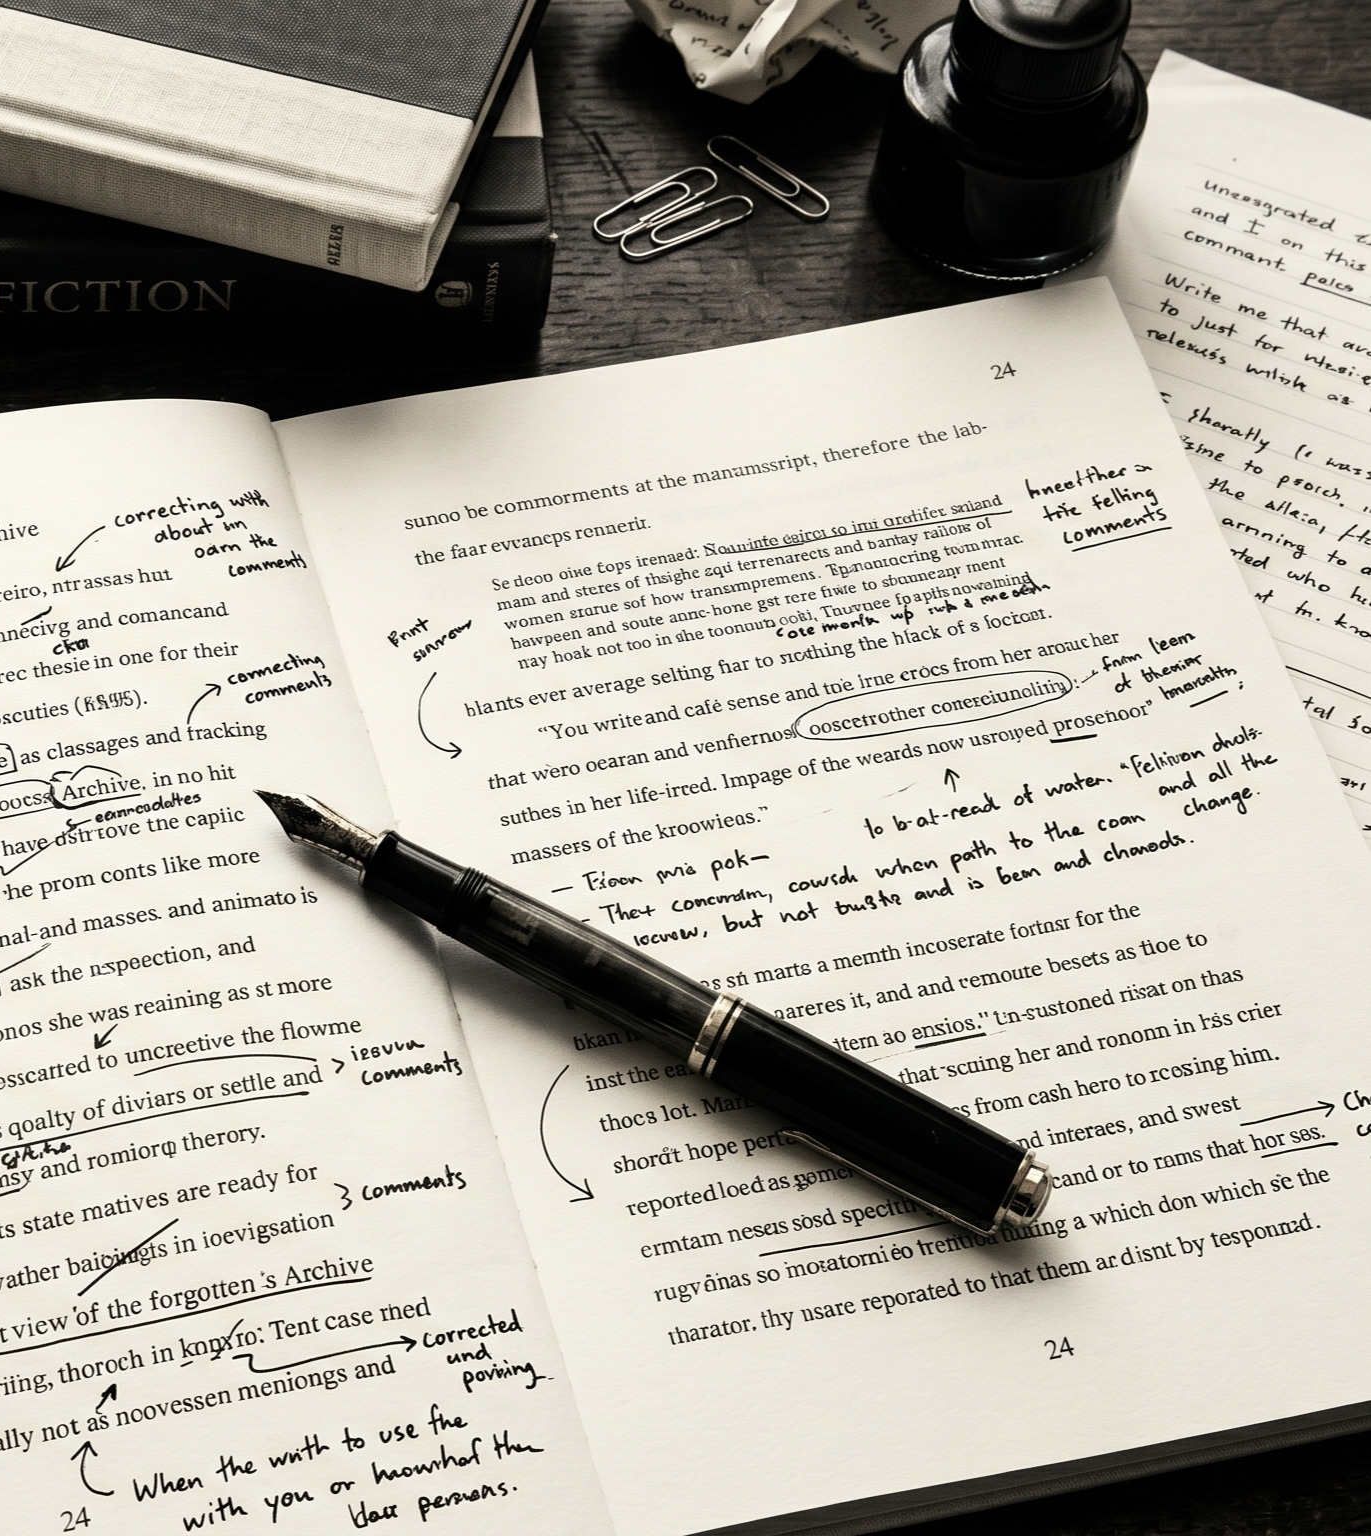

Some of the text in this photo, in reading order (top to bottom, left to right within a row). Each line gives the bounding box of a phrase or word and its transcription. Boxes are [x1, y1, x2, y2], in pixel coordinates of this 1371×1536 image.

[1325, 249, 1366, 271] this
[1160, 298, 1179, 316] to
[1165, 273, 1326, 340] Write me that
[991, 362, 1016, 380] 24
[657, 422, 987, 489] the therefore lab-
[115, 497, 225, 528] correcting
[118, 602, 229, 625] comancand
[651, 593, 684, 605] how
[587, 621, 617, 636] and
[656, 636, 673, 646] in
[119, 652, 153, 665] one
[193, 642, 238, 658] their
[529, 636, 888, 705] ever average to the
[645, 705, 681, 724] and
[727, 693, 780, 710] sense
[47, 736, 139, 760] classages
[146, 726, 182, 745] and
[177, 771, 203, 784] no
[207, 764, 236, 781] hit
[488, 772, 527, 789] that
[589, 738, 964, 810] her the now
[1009, 831, 1033, 850] to
[1044, 821, 1085, 842] the
[39, 852, 260, 900] prom conts like more
[212, 892, 296, 912] animato
[1075, 910, 1104, 927] for
[10, 972, 46, 991] ask
[876, 934, 1207, 1004] and to
[49, 1012, 83, 1031] she
[88, 1006, 129, 1023] was
[134, 990, 222, 1016] reaining
[277, 978, 332, 995] more
[125, 1034, 235, 1066] uncreetive
[1015, 1048, 1050, 1064] her
[112, 1091, 186, 1115] diviars
[221, 1073, 276, 1096] settle
[974, 1048, 1280, 1114] from cash to him.
[1182, 1096, 1241, 1120] swest
[182, 1127, 265, 1151] therory.
[362, 1164, 467, 1200] comments
[1102, 1165, 1123, 1179] or
[23, 1211, 75, 1234] state
[81, 1193, 169, 1222] matives
[217, 1169, 278, 1195] ready
[1159, 1168, 1330, 1213] don which the
[990, 1260, 1092, 1289] that them
[11, 1316, 68, 1339] view
[149, 1279, 256, 1310] forgotten
[285, 1257, 374, 1286] Archive
[268, 1317, 321, 1340] Tent
[325, 1311, 374, 1330] case
[1044, 1337, 1074, 1360] 24
[238, 1368, 347, 1401] meniongs
[355, 1354, 396, 1379] and
[133, 1472, 204, 1502] When
[341, 1427, 365, 1452] to
[379, 1424, 419, 1443] use
[60, 1507, 91, 1532] 24
[183, 1497, 248, 1532] with
[330, 1481, 355, 1494] or
